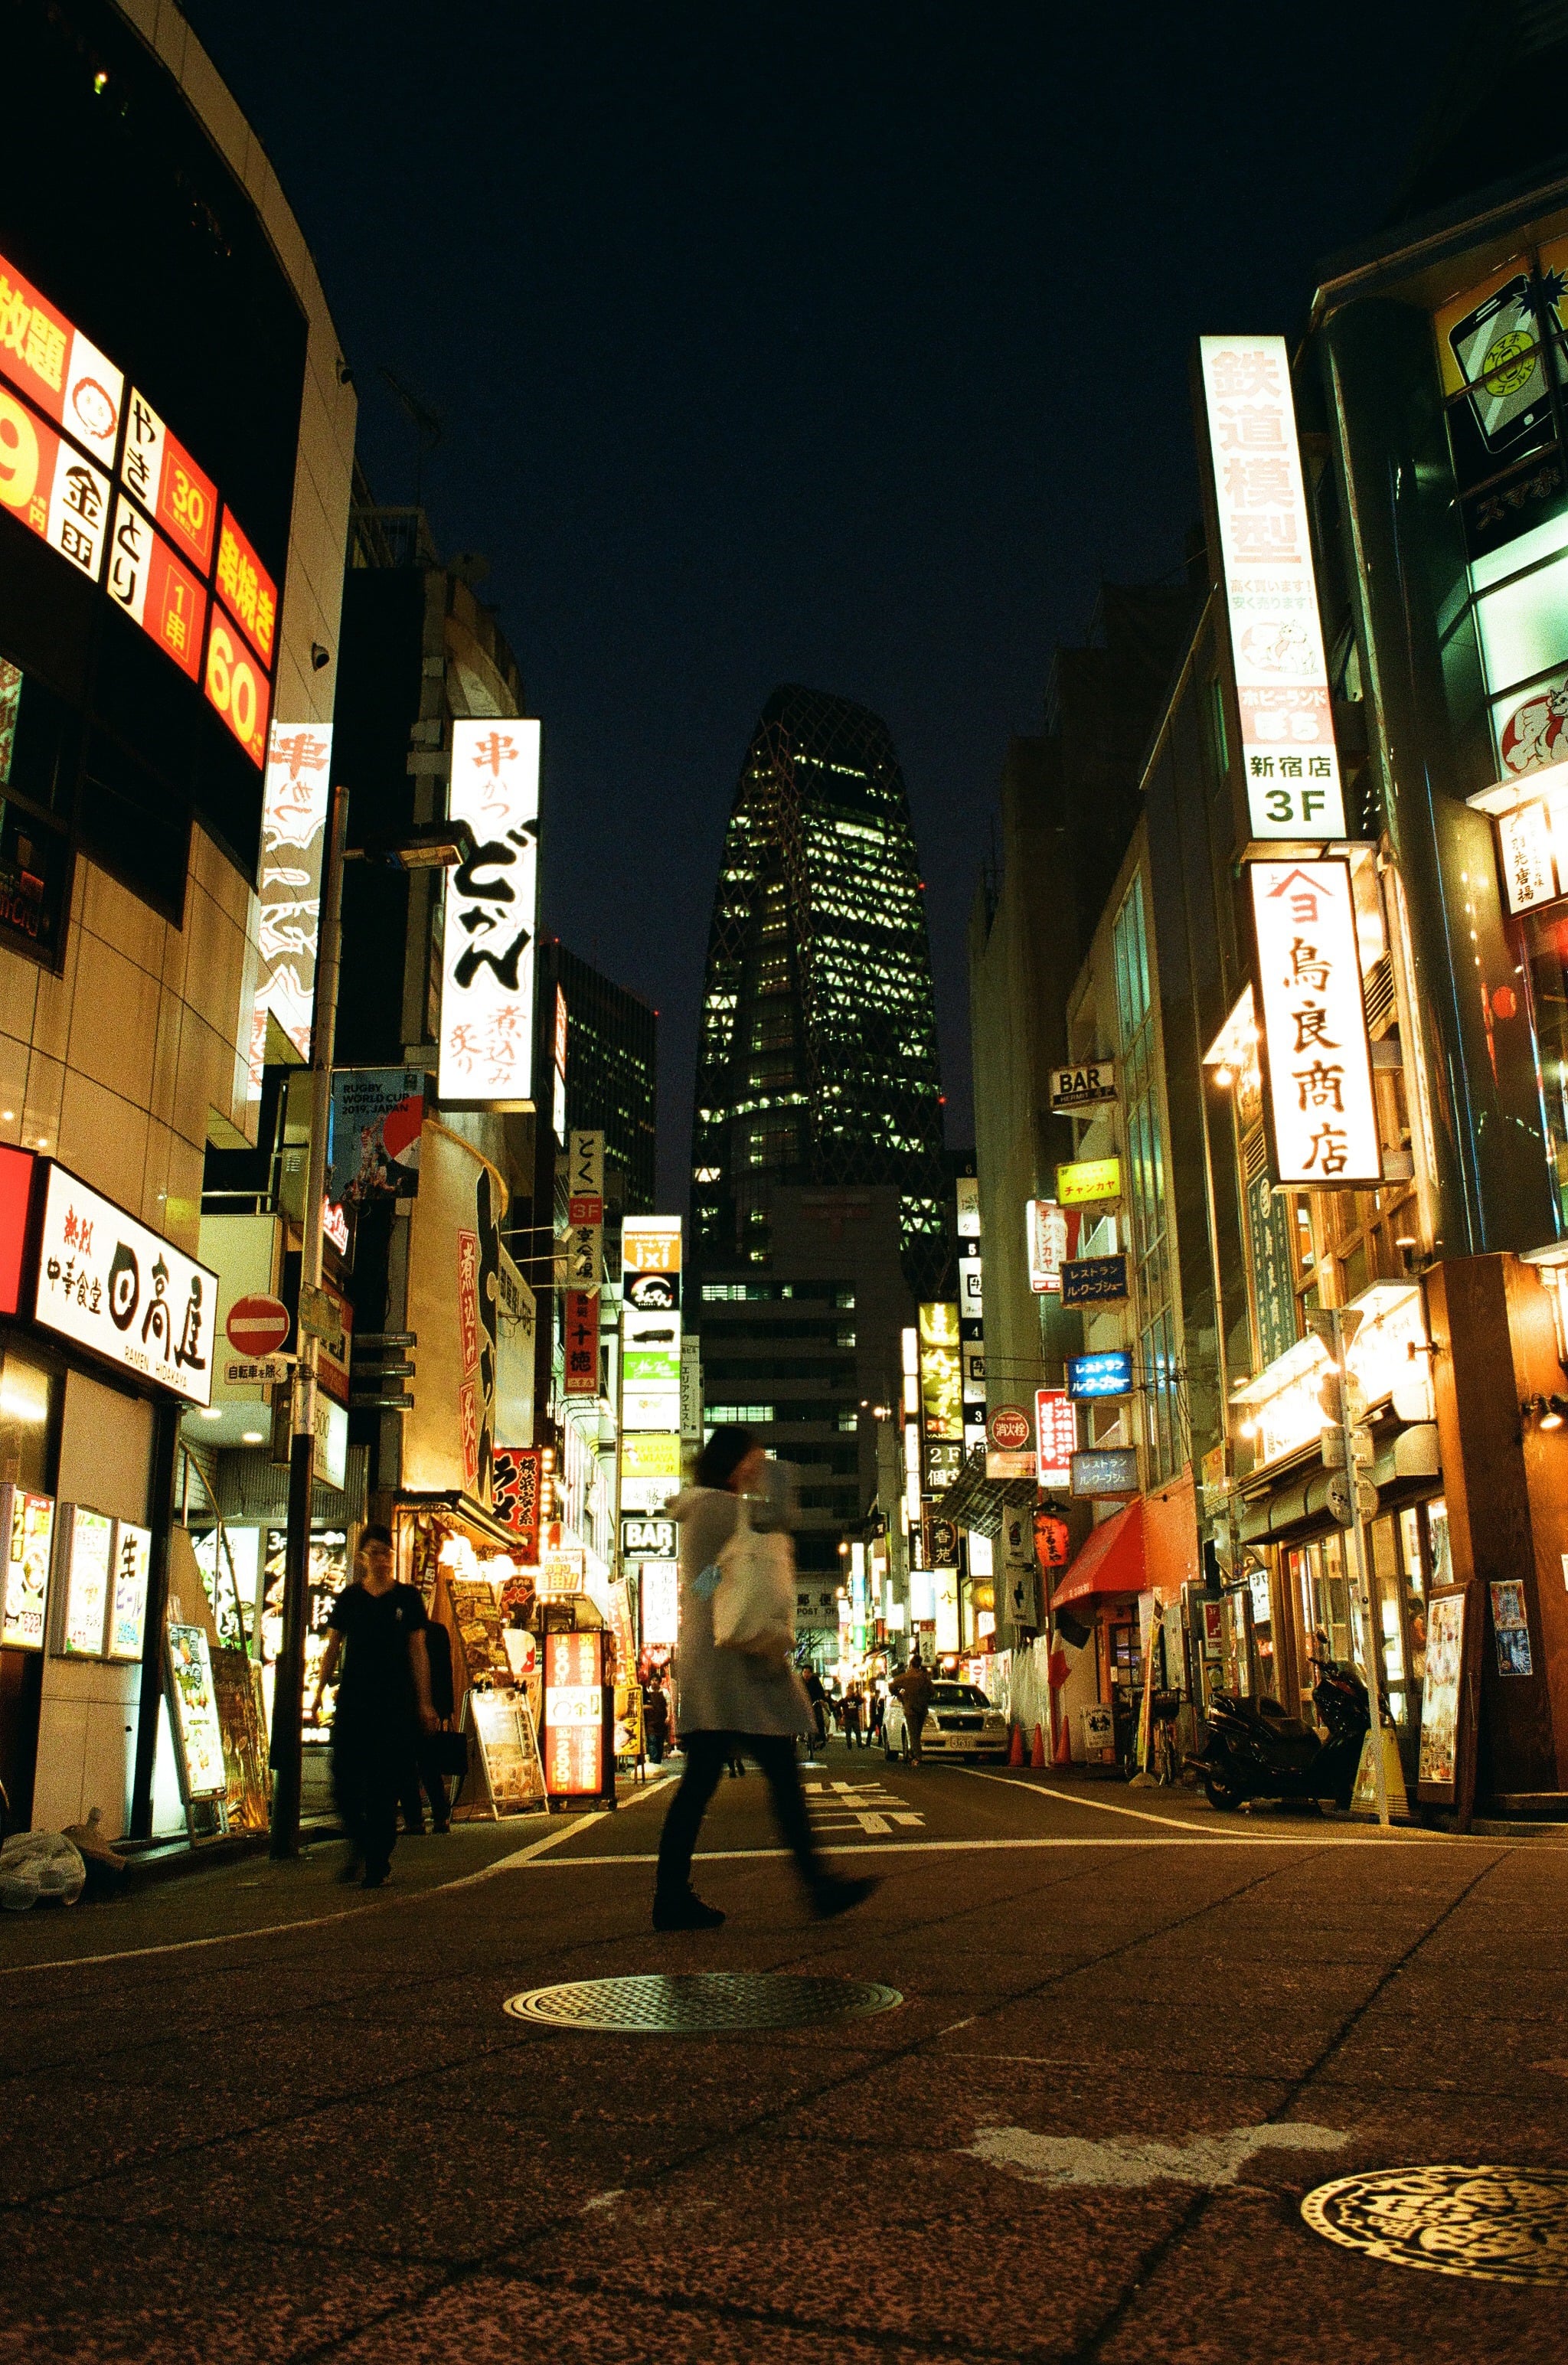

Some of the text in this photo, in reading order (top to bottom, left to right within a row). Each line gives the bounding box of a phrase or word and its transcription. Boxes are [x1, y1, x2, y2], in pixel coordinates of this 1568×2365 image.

[1488, 332, 1521, 363] スマホ
[127, 399, 156, 500] やき
[1211, 351, 1302, 565] 鉄道模型
[172, 469, 204, 531] 30
[63, 522, 91, 567] 3F
[113, 511, 142, 606] とり
[217, 524, 274, 655] 串焼き
[207, 627, 256, 743] 60
[1241, 688, 1327, 708] ホビーランド
[472, 731, 520, 818] 串かつ
[1250, 755, 1331, 778] 新宿店
[1265, 789, 1325, 822] 3F
[483, 1004, 527, 1086] 煮込み
[1282, 936, 1349, 1177] 鳥良商店
[344, 1083, 382, 1093] RUGBY
[1060, 1068, 1100, 1094] BAR
[343, 1093, 410, 1104] WORLD CUP
[371, 1103, 409, 1113] JAPAN
[1064, 1180, 1116, 1196] チャンカヤ
[573, 1203, 600, 1219] 3F
[64, 1204, 94, 1259] 熱烈
[969, 1243, 976, 1256] 5
[47, 1254, 101, 1315] 中華食堂
[1071, 1266, 1118, 1279] レストラン
[108, 1238, 207, 1370] 日高屋
[461, 1243, 475, 1365] 煮込み
[972, 1326, 980, 1338] 4
[125, 1345, 188, 1390] RAMEN HIDAKAYA
[228, 1364, 283, 1380] 自転車を除く
[1076, 1360, 1124, 1375] レストラン
[975, 1410, 982, 1423] 3
[995, 1423, 1026, 1438] 消火栓
[929, 1447, 960, 1462] 2F
[518, 1457, 537, 1527] 横浜家系
[626, 1522, 672, 1548] BAR
[119, 1533, 138, 1580] 生
[555, 1646, 570, 1676] 60
